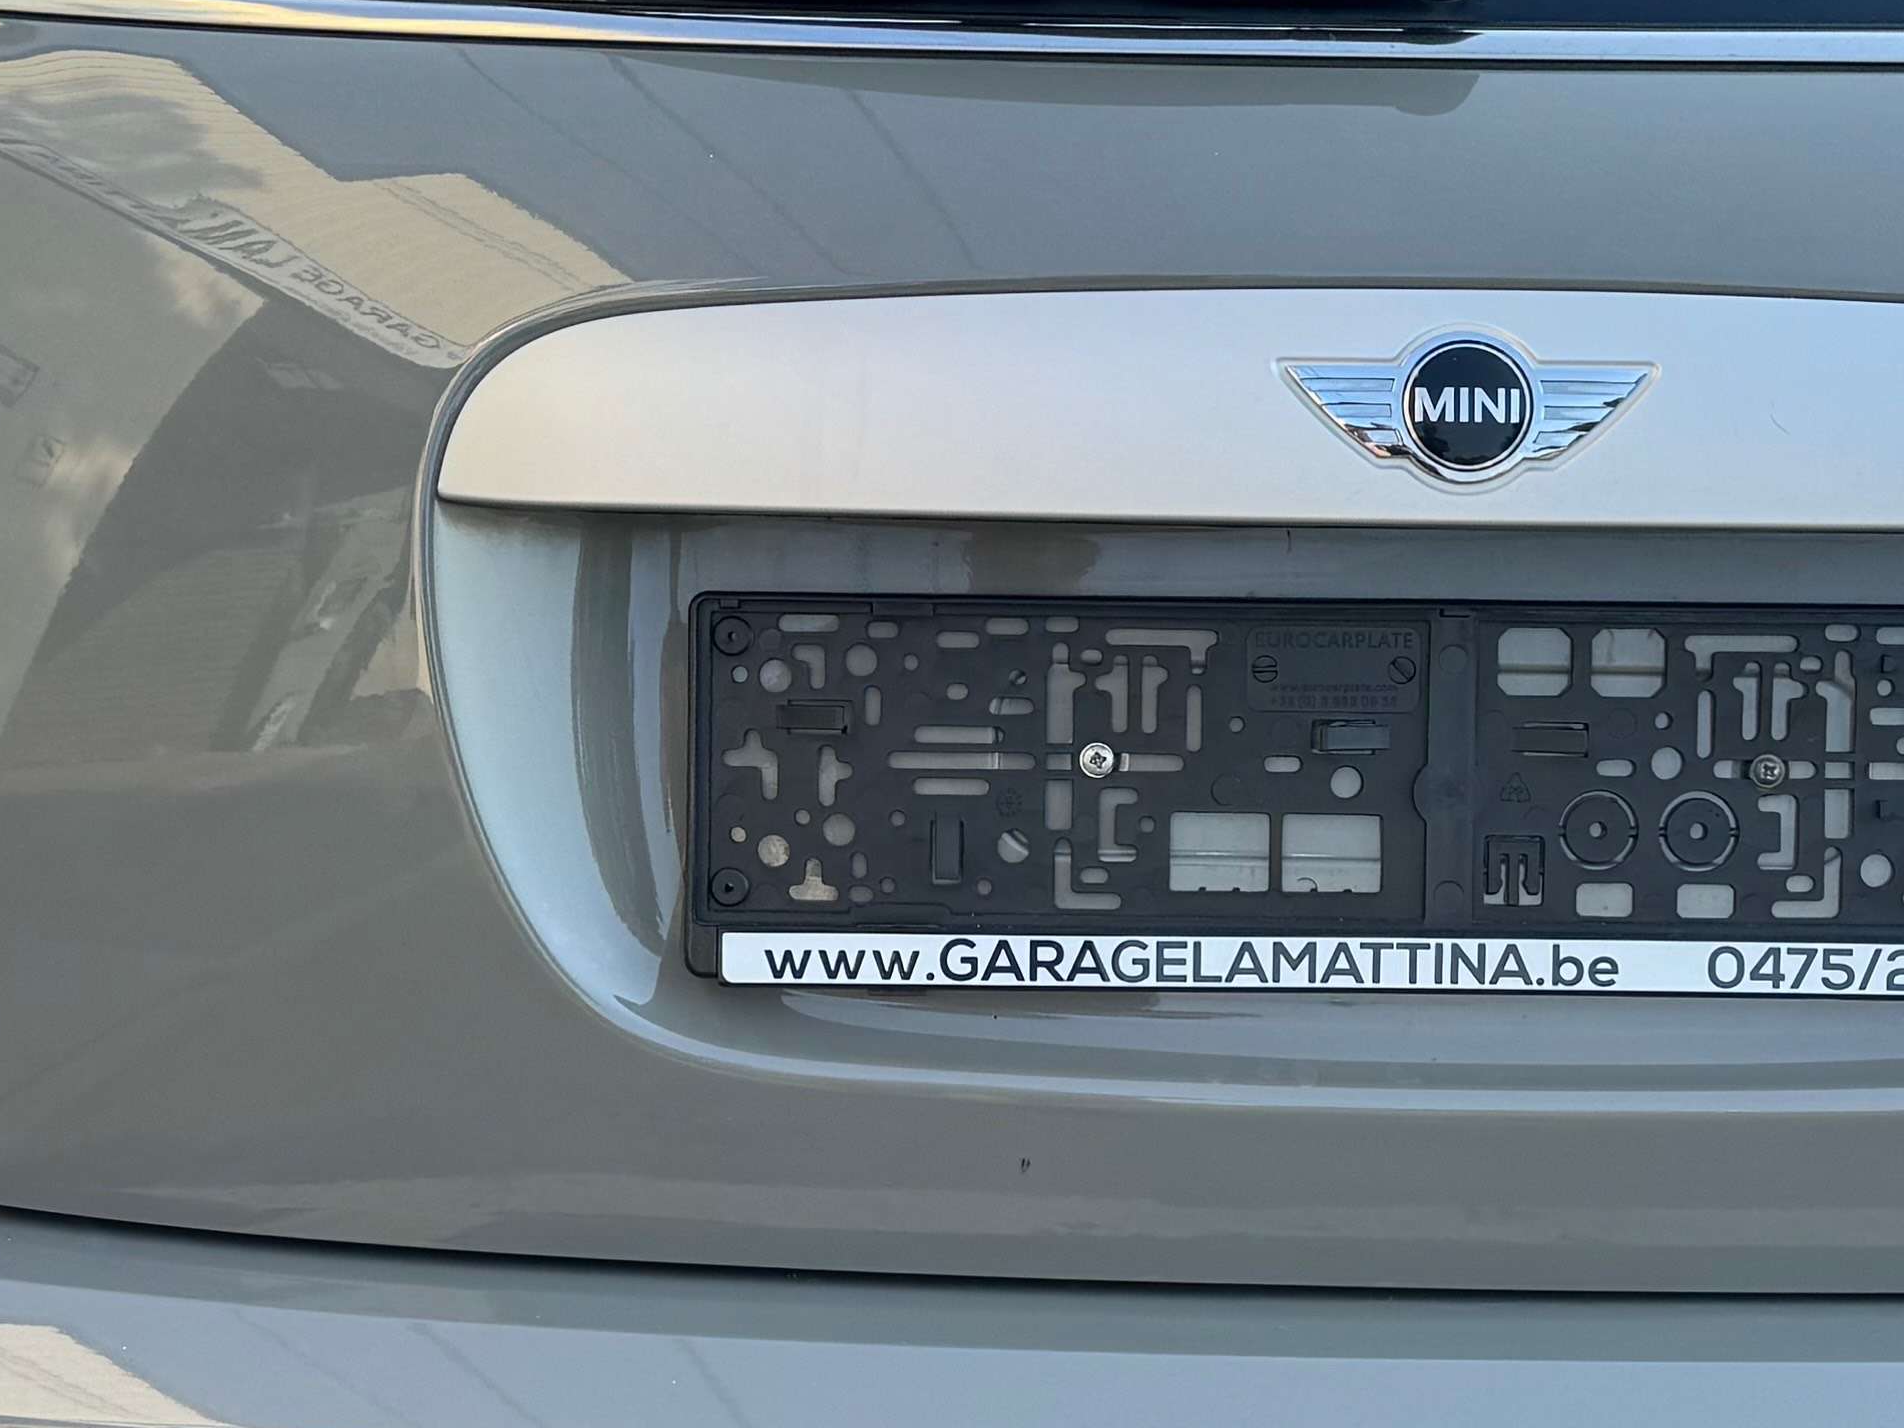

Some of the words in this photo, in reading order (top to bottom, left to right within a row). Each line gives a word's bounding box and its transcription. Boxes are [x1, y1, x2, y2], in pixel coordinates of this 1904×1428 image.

[1414, 386, 1520, 424] MINI
[1255, 631, 1414, 650] EUROCARPLATE
[763, 937, 1621, 989] www.GARAGELAMATTINA.be
